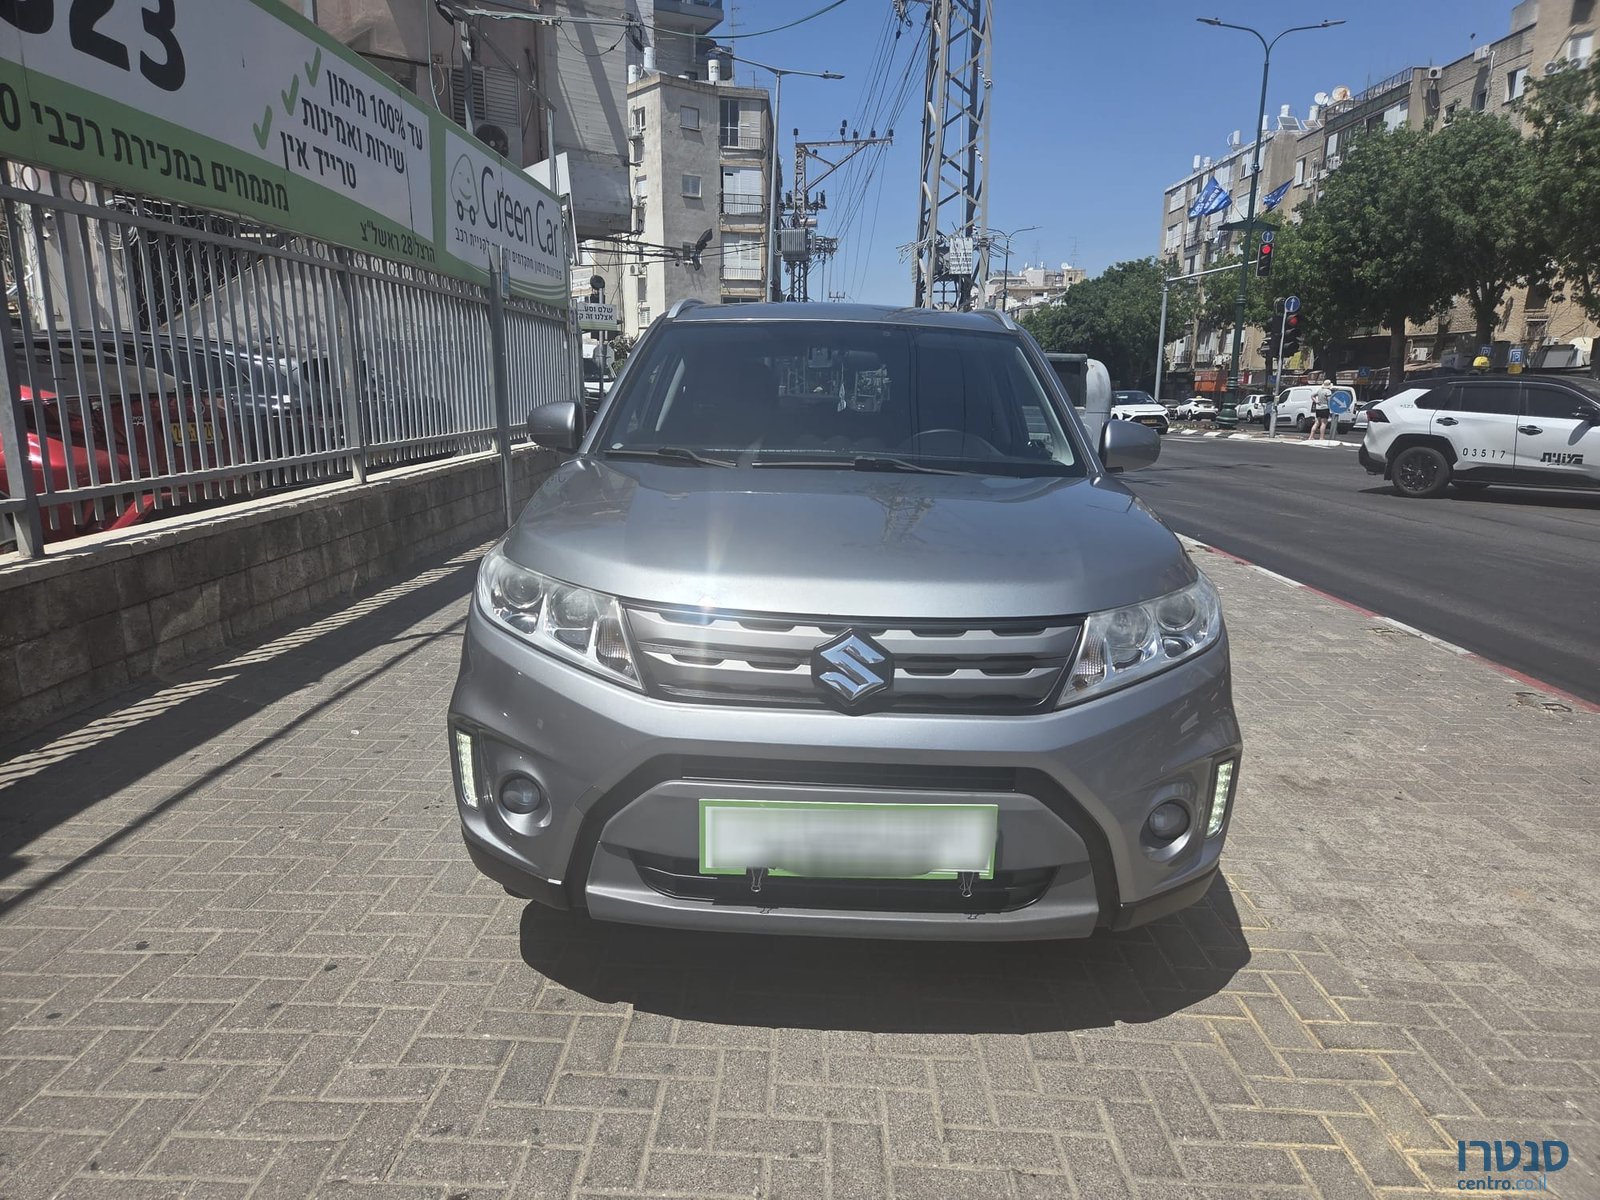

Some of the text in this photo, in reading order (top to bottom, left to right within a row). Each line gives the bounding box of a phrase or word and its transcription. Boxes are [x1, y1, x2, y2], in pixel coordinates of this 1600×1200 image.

[0, 0, 186, 91] 23
[30, 101, 104, 157] רכבי
[301, 97, 405, 174] שירות ואמינות
[326, 69, 423, 150] עד 100% מימון
[111, 128, 207, 188] במכירת
[280, 130, 357, 189] טרייד אין
[211, 161, 289, 212] מתמחים
[481, 166, 558, 259] Green Car
[401, 233, 413, 256] 28
[415, 237, 436, 264] הרצל
[455, 227, 468, 243] רכב
[594, 313, 613, 321] אצלנו
[598, 305, 613, 314] שלם
[1462, 447, 1506, 460] 03517
